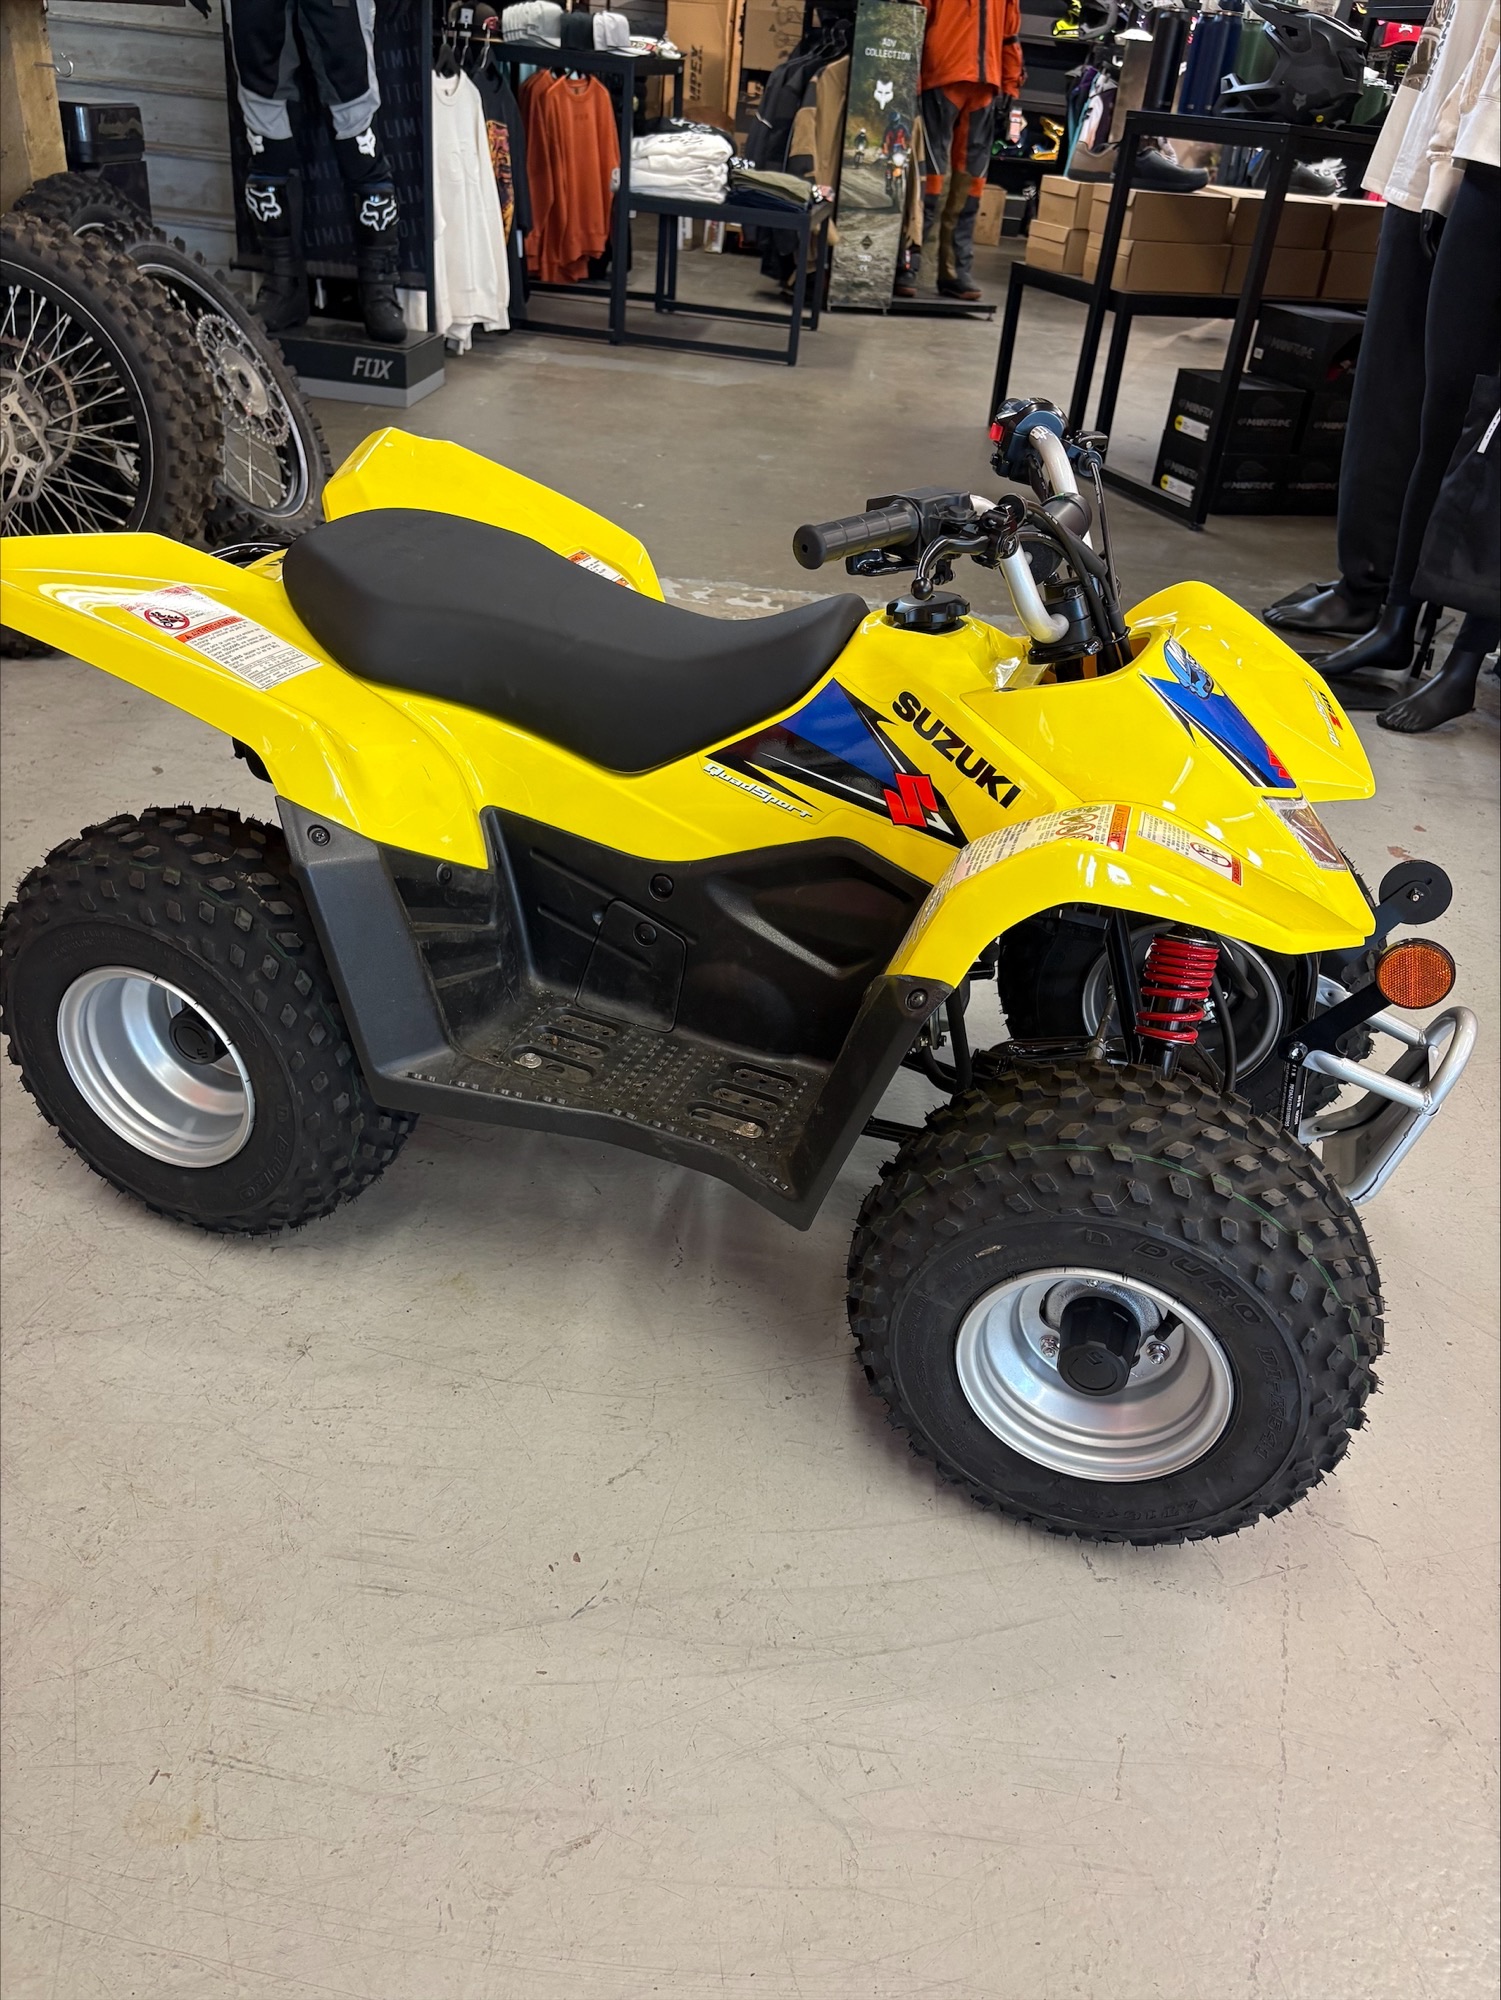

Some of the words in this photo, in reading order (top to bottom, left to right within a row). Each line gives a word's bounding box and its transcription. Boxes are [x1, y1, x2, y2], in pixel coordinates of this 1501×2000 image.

[864, 47, 912, 61] COLLECTION
[881, 37, 897, 48] ADV
[352, 356, 394, 380] FOX
[892, 691, 1022, 809] SUZUKI
[703, 762, 813, 819] QuadSport
[1132, 1240, 1263, 1325] DURO
